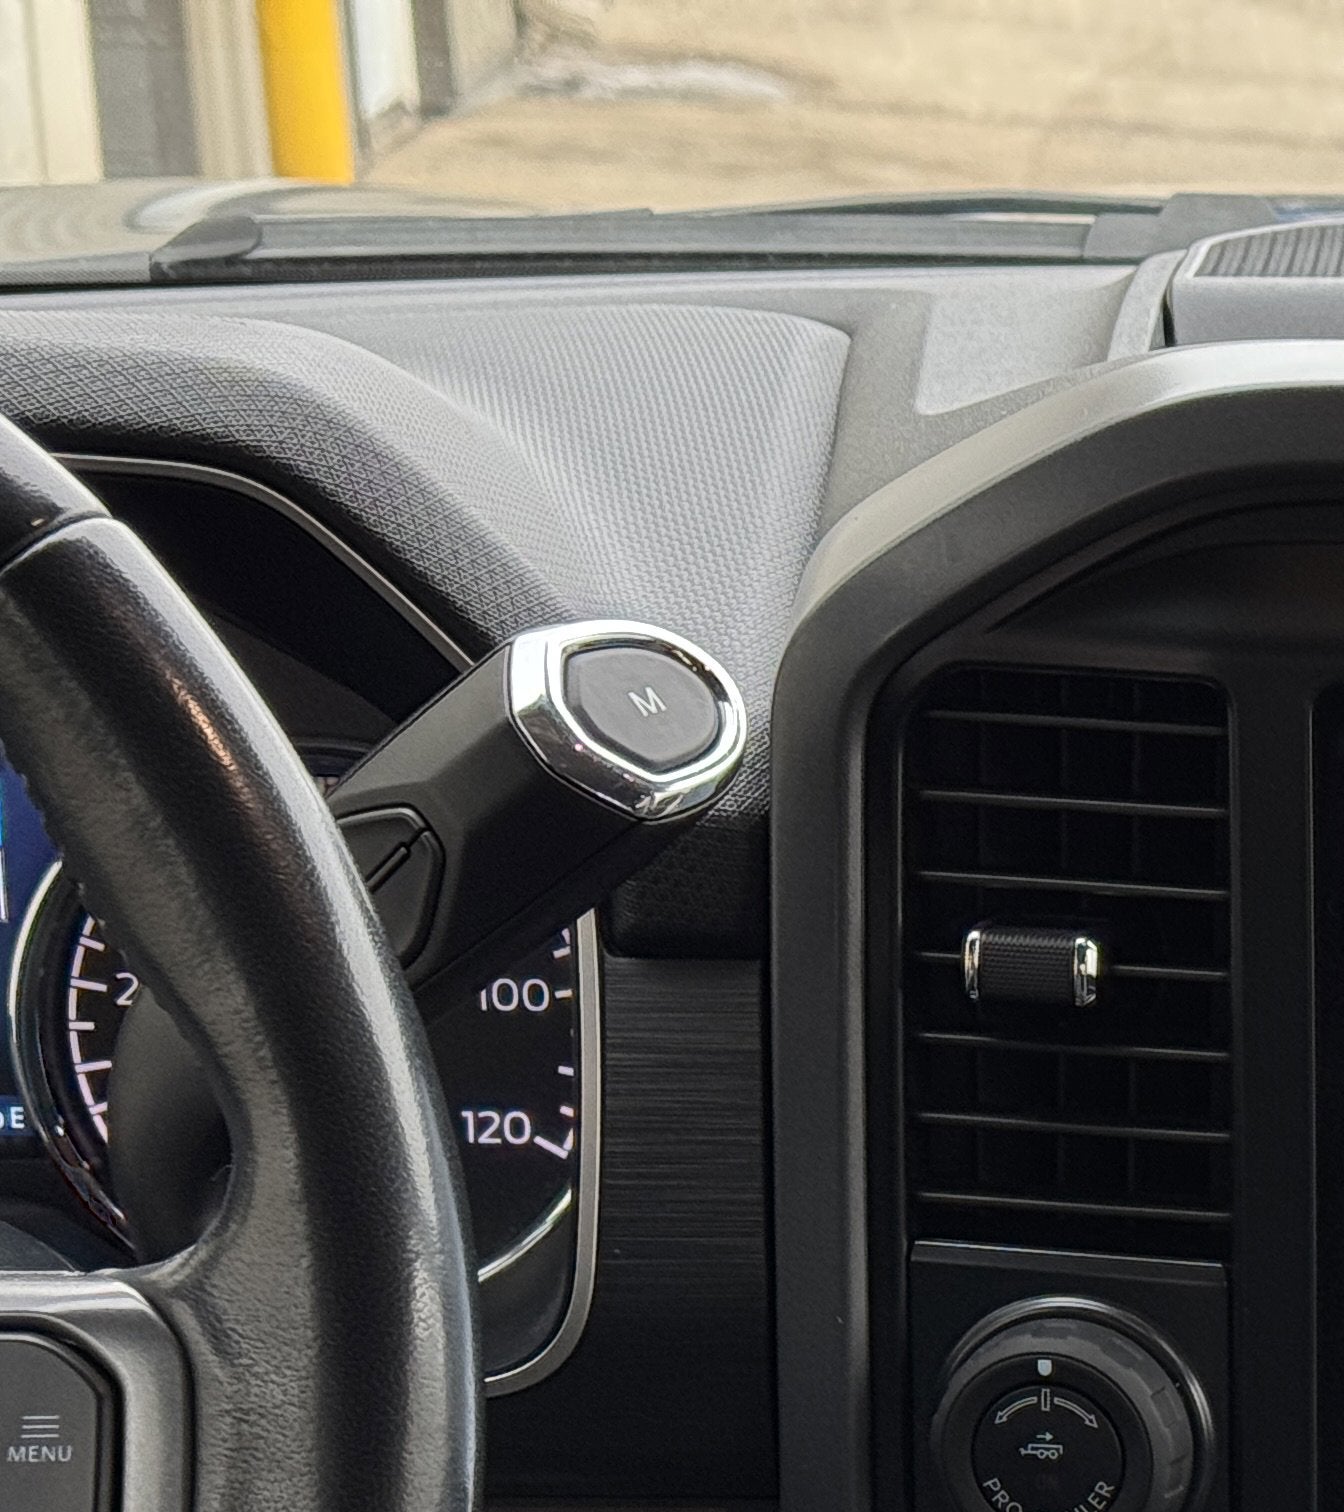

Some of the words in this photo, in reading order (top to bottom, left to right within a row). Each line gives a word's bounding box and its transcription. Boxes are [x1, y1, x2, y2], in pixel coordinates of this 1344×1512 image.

[628, 687, 667, 717] M
[116, 972, 139, 1006] 2
[461, 1110, 532, 1145] 120
[7, 1445, 73, 1463] MENU
